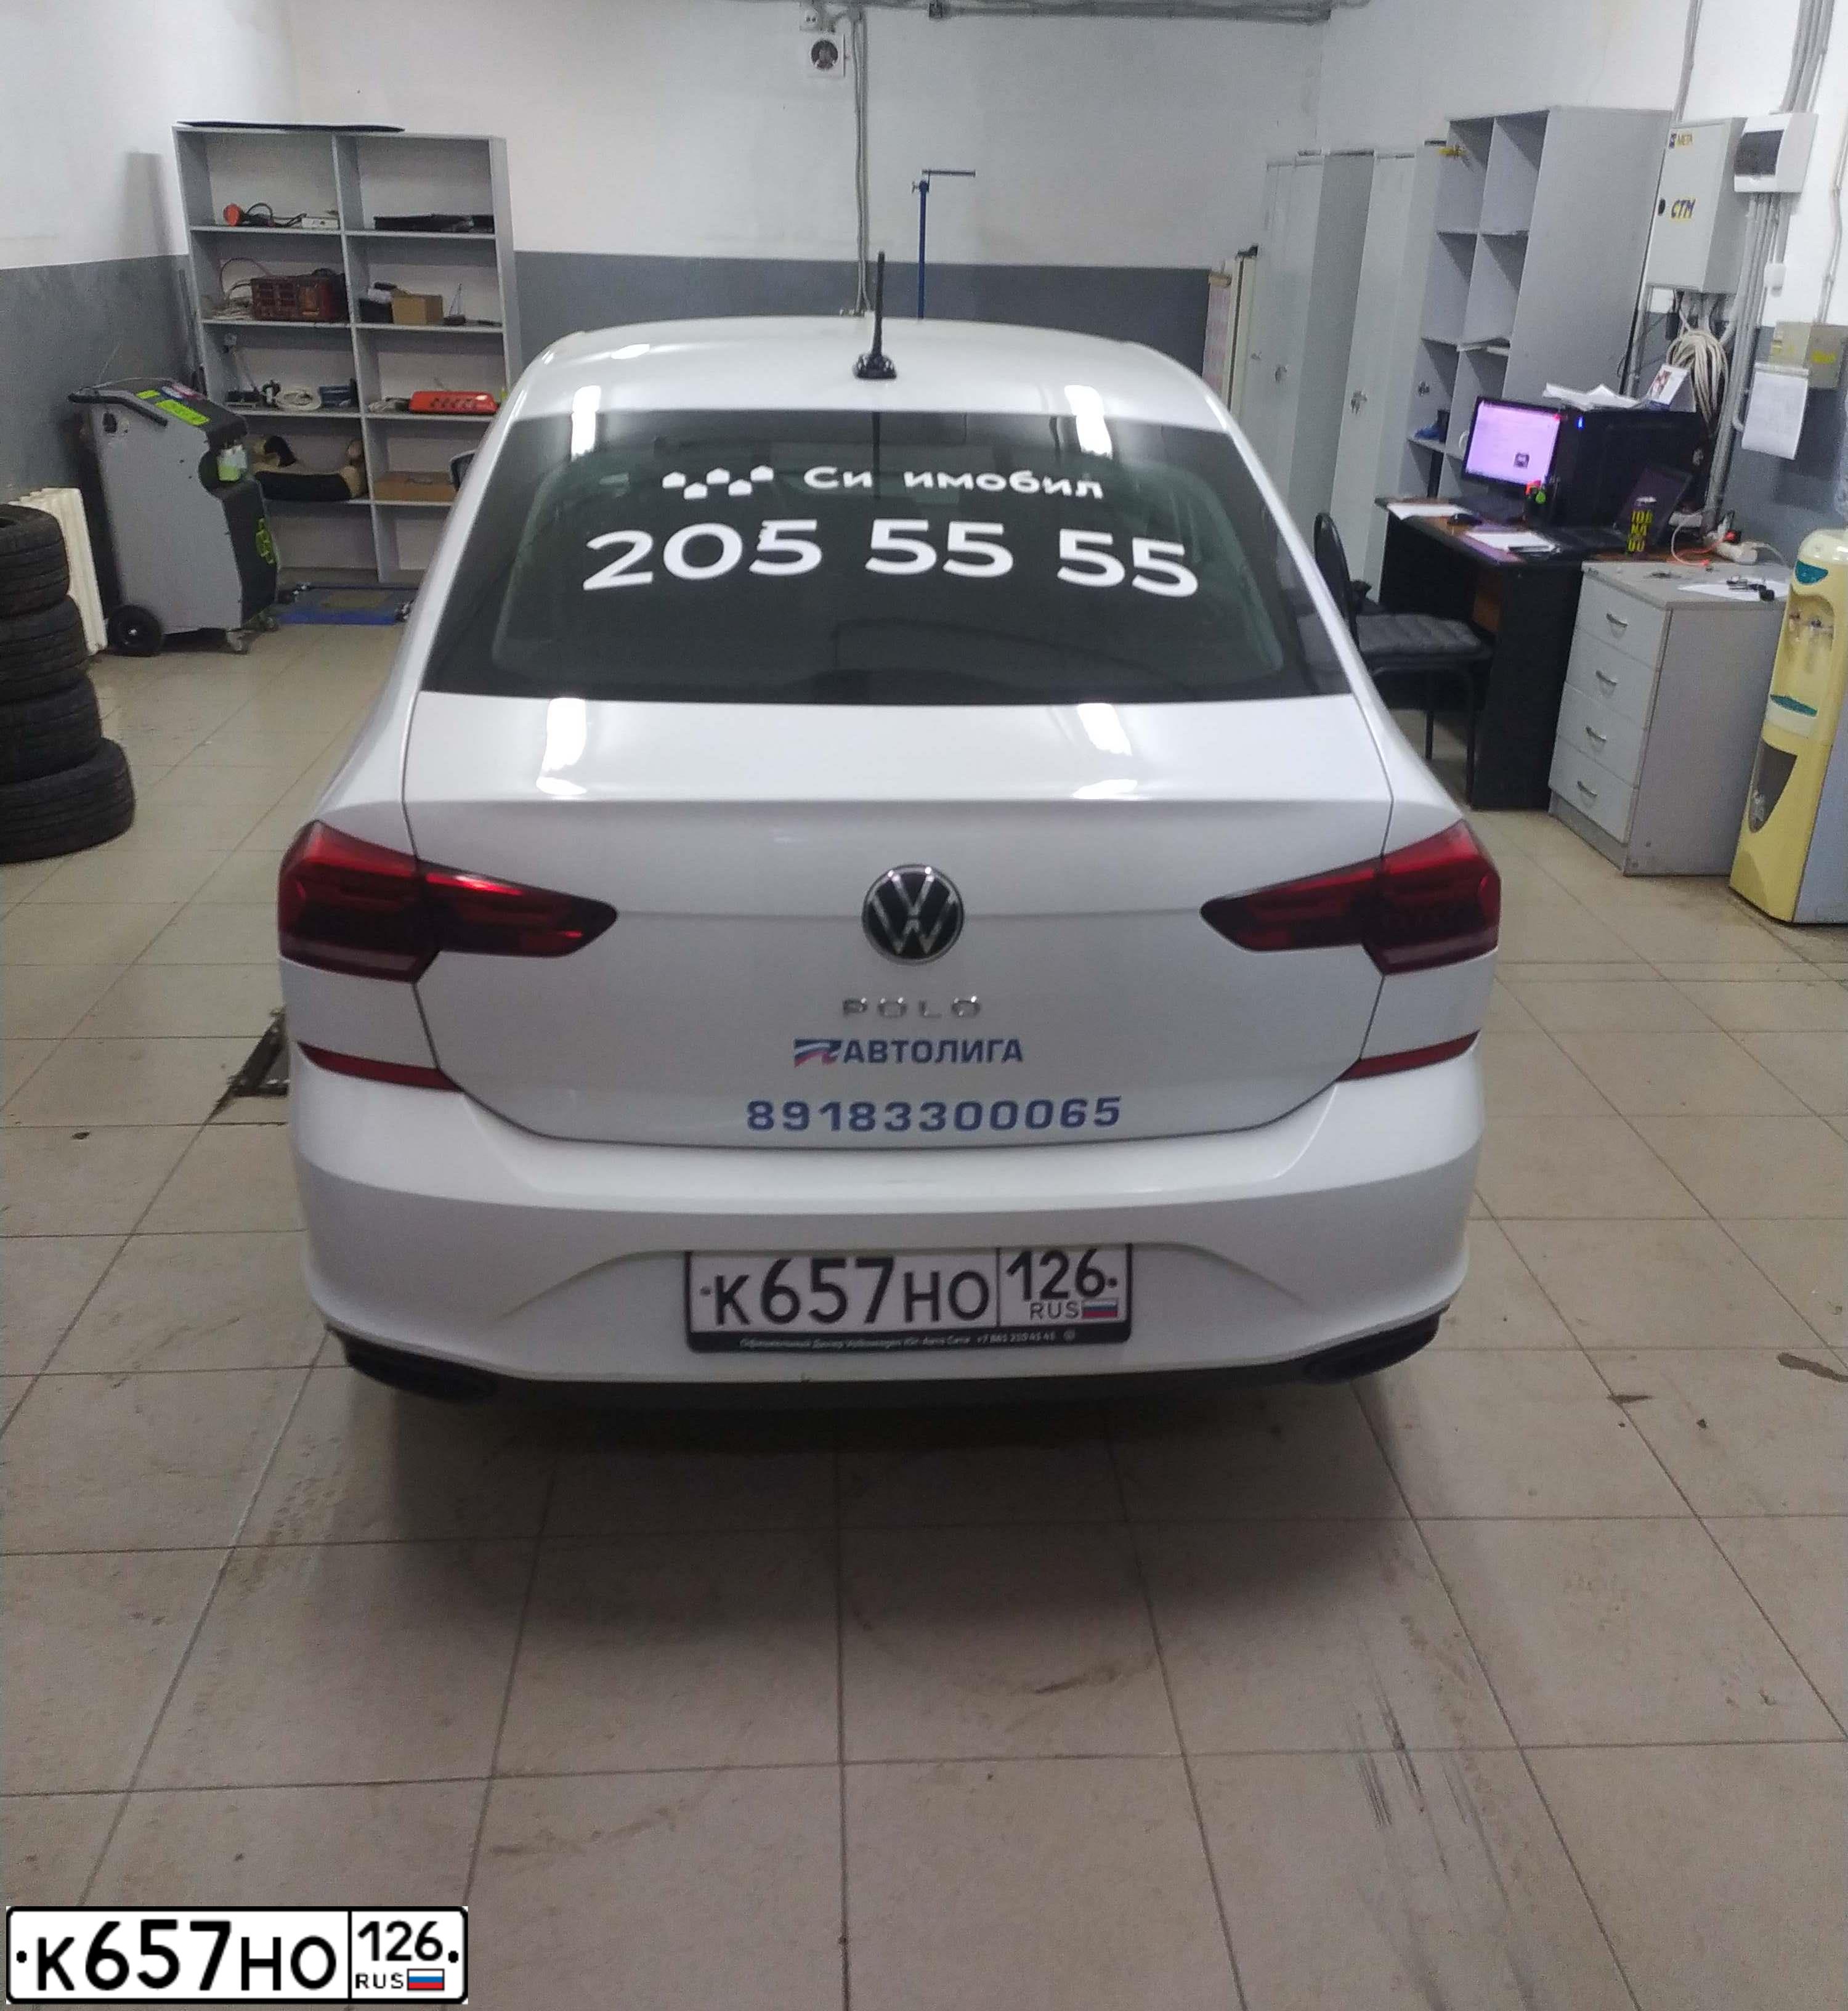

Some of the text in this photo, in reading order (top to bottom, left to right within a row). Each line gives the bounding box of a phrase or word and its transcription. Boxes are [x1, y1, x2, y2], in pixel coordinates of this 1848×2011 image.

[582, 518, 1199, 598] 205 55 55
[842, 995, 981, 1019] POLO
[841, 1037, 1024, 1066] АВТОЛИГА
[746, 1094, 1122, 1132] 89183300065
[1005, 1248, 1106, 1301] 126
[1029, 1301, 1080, 1320] RUS
